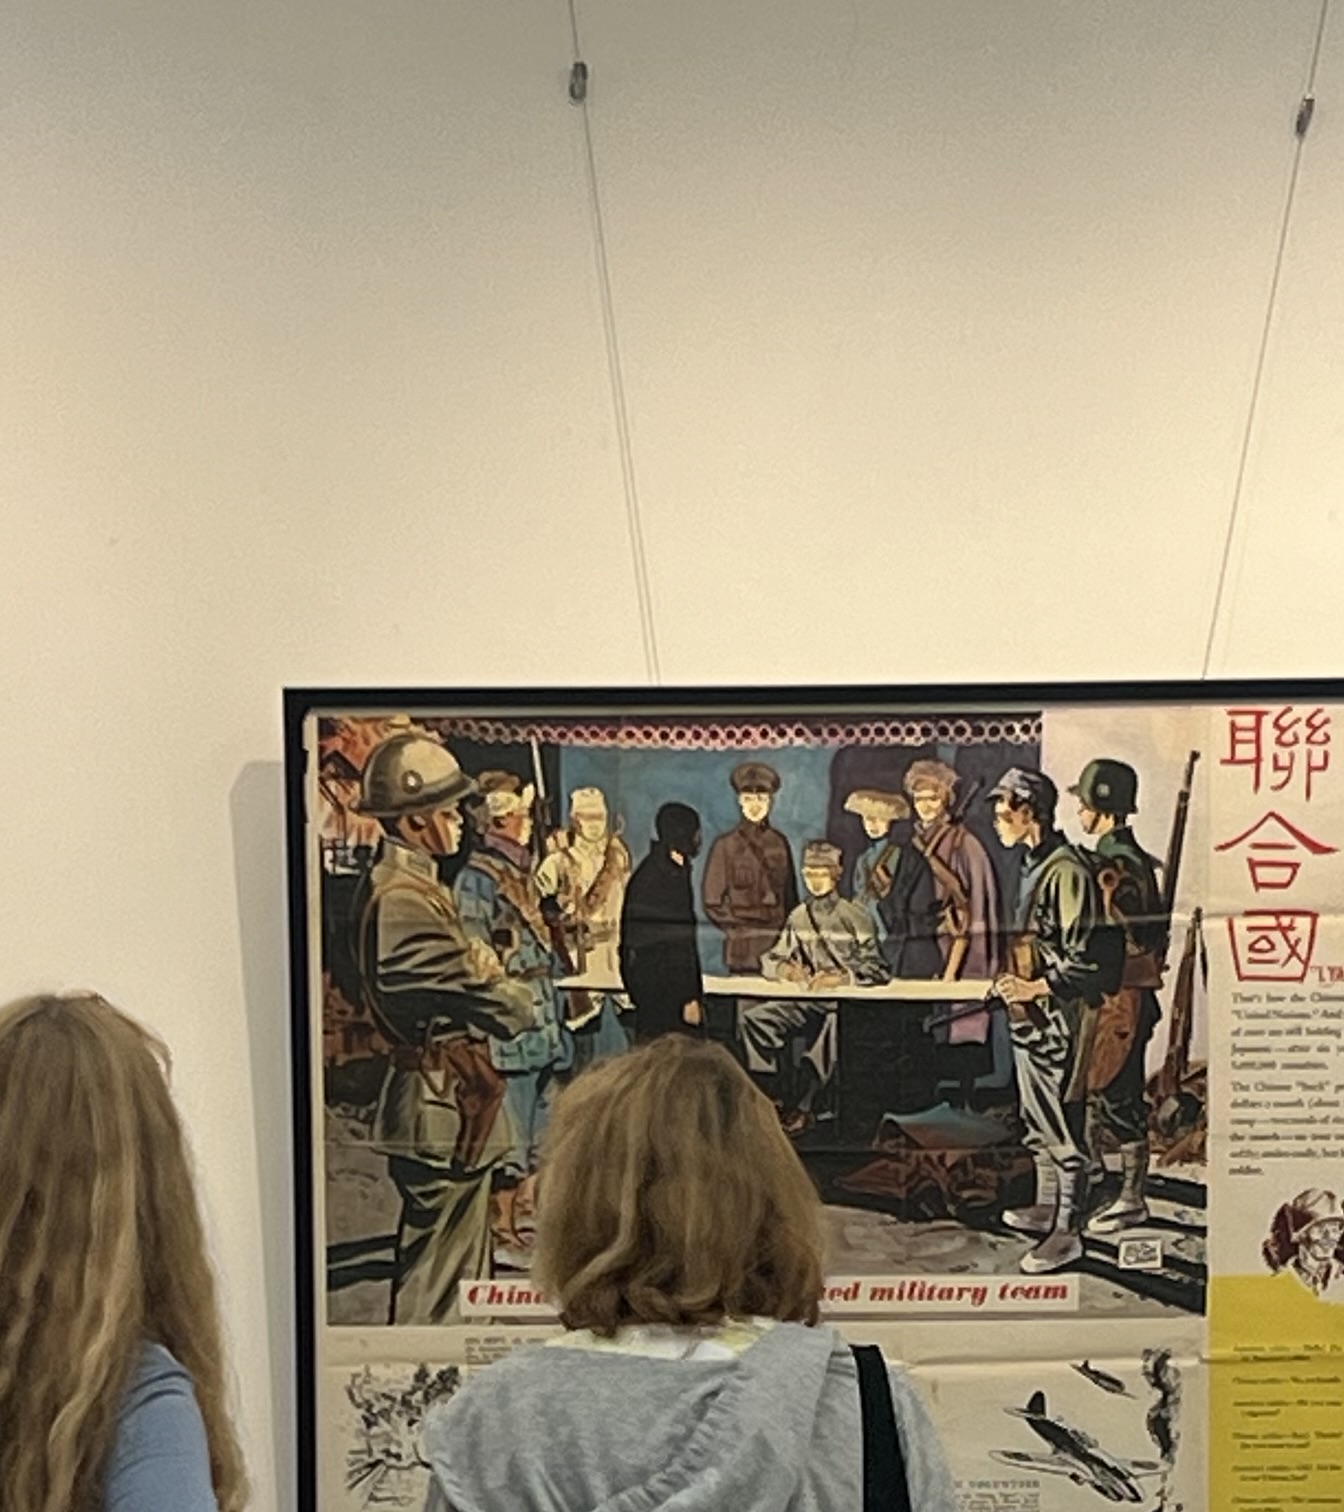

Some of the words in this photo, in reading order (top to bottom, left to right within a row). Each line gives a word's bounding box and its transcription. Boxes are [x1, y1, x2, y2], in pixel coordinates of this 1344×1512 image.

[1214, 706, 1341, 982] 聯合國
[869, 1280, 989, 1307] military
[998, 1281, 1069, 1300] team
